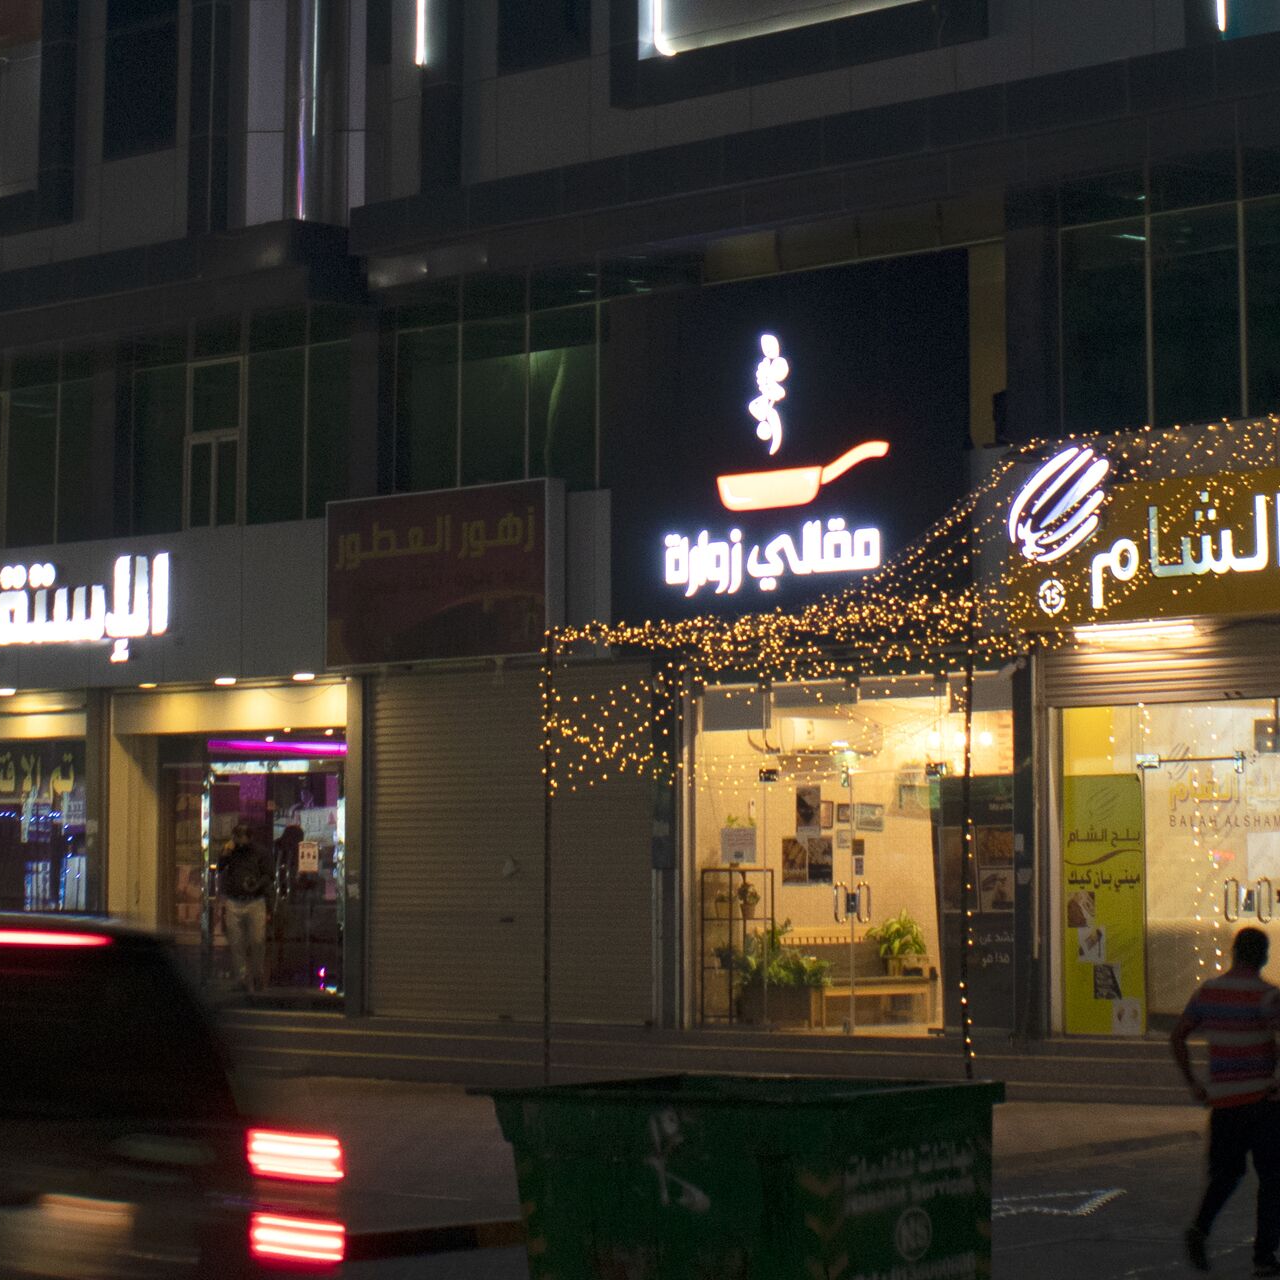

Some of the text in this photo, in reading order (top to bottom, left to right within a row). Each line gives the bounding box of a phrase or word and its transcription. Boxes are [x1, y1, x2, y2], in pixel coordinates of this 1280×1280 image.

[335, 514, 452, 570] العطور
[746, 517, 881, 591] مقالي
[1067, 824, 1141, 848] بلح الشام
[1169, 815, 1218, 828] BALAH
